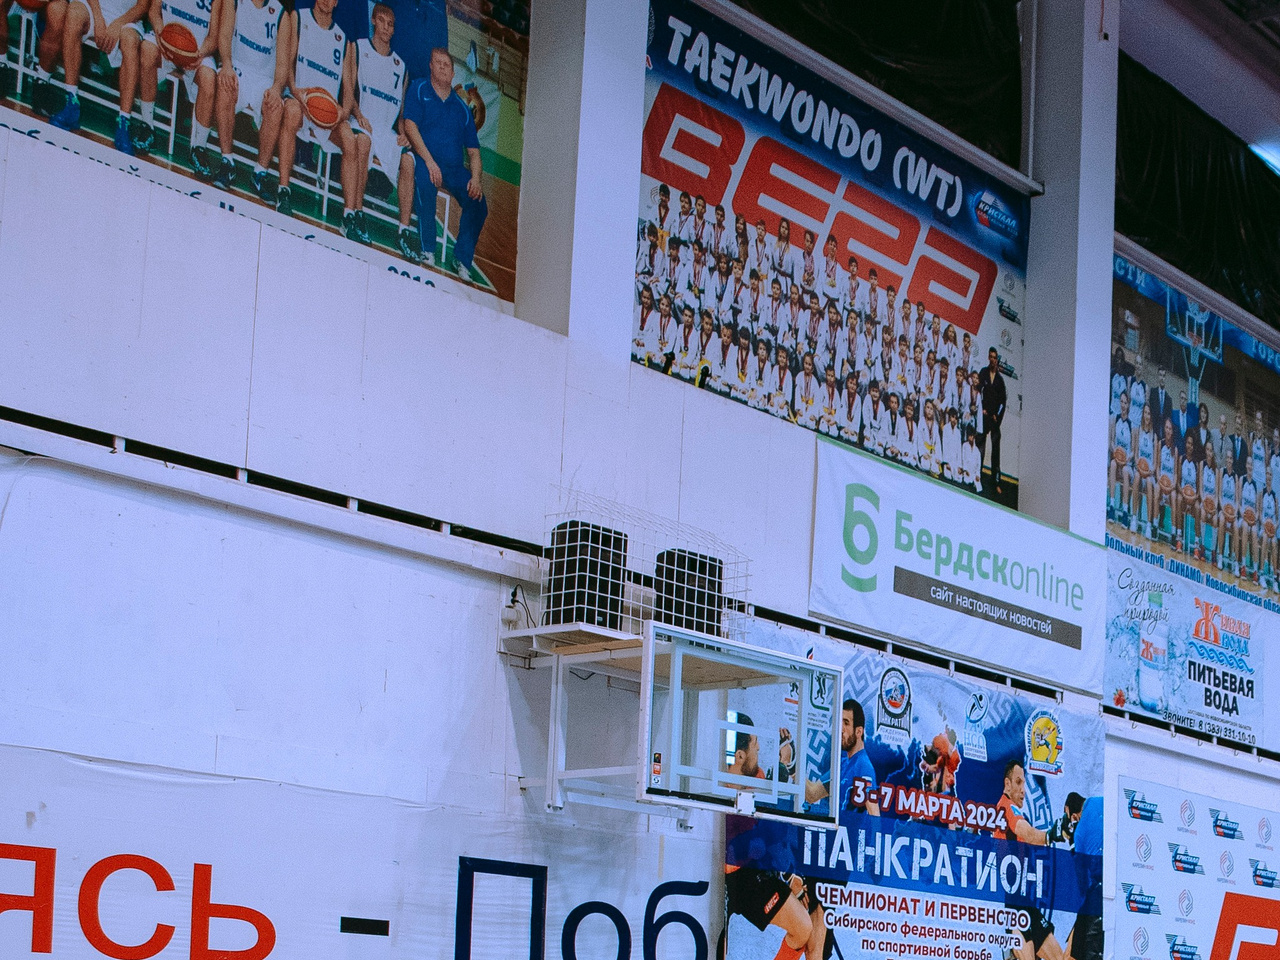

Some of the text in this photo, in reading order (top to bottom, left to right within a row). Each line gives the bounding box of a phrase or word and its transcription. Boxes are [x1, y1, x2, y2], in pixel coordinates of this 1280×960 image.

[333, 48, 340, 65] 9
[667, 15, 964, 217] TAEKWONDO (WT)
[1118, 568, 1176, 606] Созданная
[930, 586, 1052, 635] сайт настоящих новостей
[1188, 660, 1255, 699] ПИТЬЕВАЯ
[1204, 687, 1239, 717] ВОДА
[1162, 711, 1256, 745] ЗВОНИТЕ! 8 (383) 331-10-10
[853, 780, 865, 804] 3
[880, 786, 892, 809] 7
[898, 791, 963, 822] МАРТА
[966, 804, 1007, 829] 2024
[803, 826, 1044, 898] ПАНКРАТИОН
[340, 916, 389, 937] -
[817, 886, 1030, 929] ЧЕМПИОНАТ И ПЕРВЕНСТВО
[825, 911, 1021, 951] Сибирского федерального округа
[861, 939, 875, 951] по
[878, 941, 951, 959] спортивной
